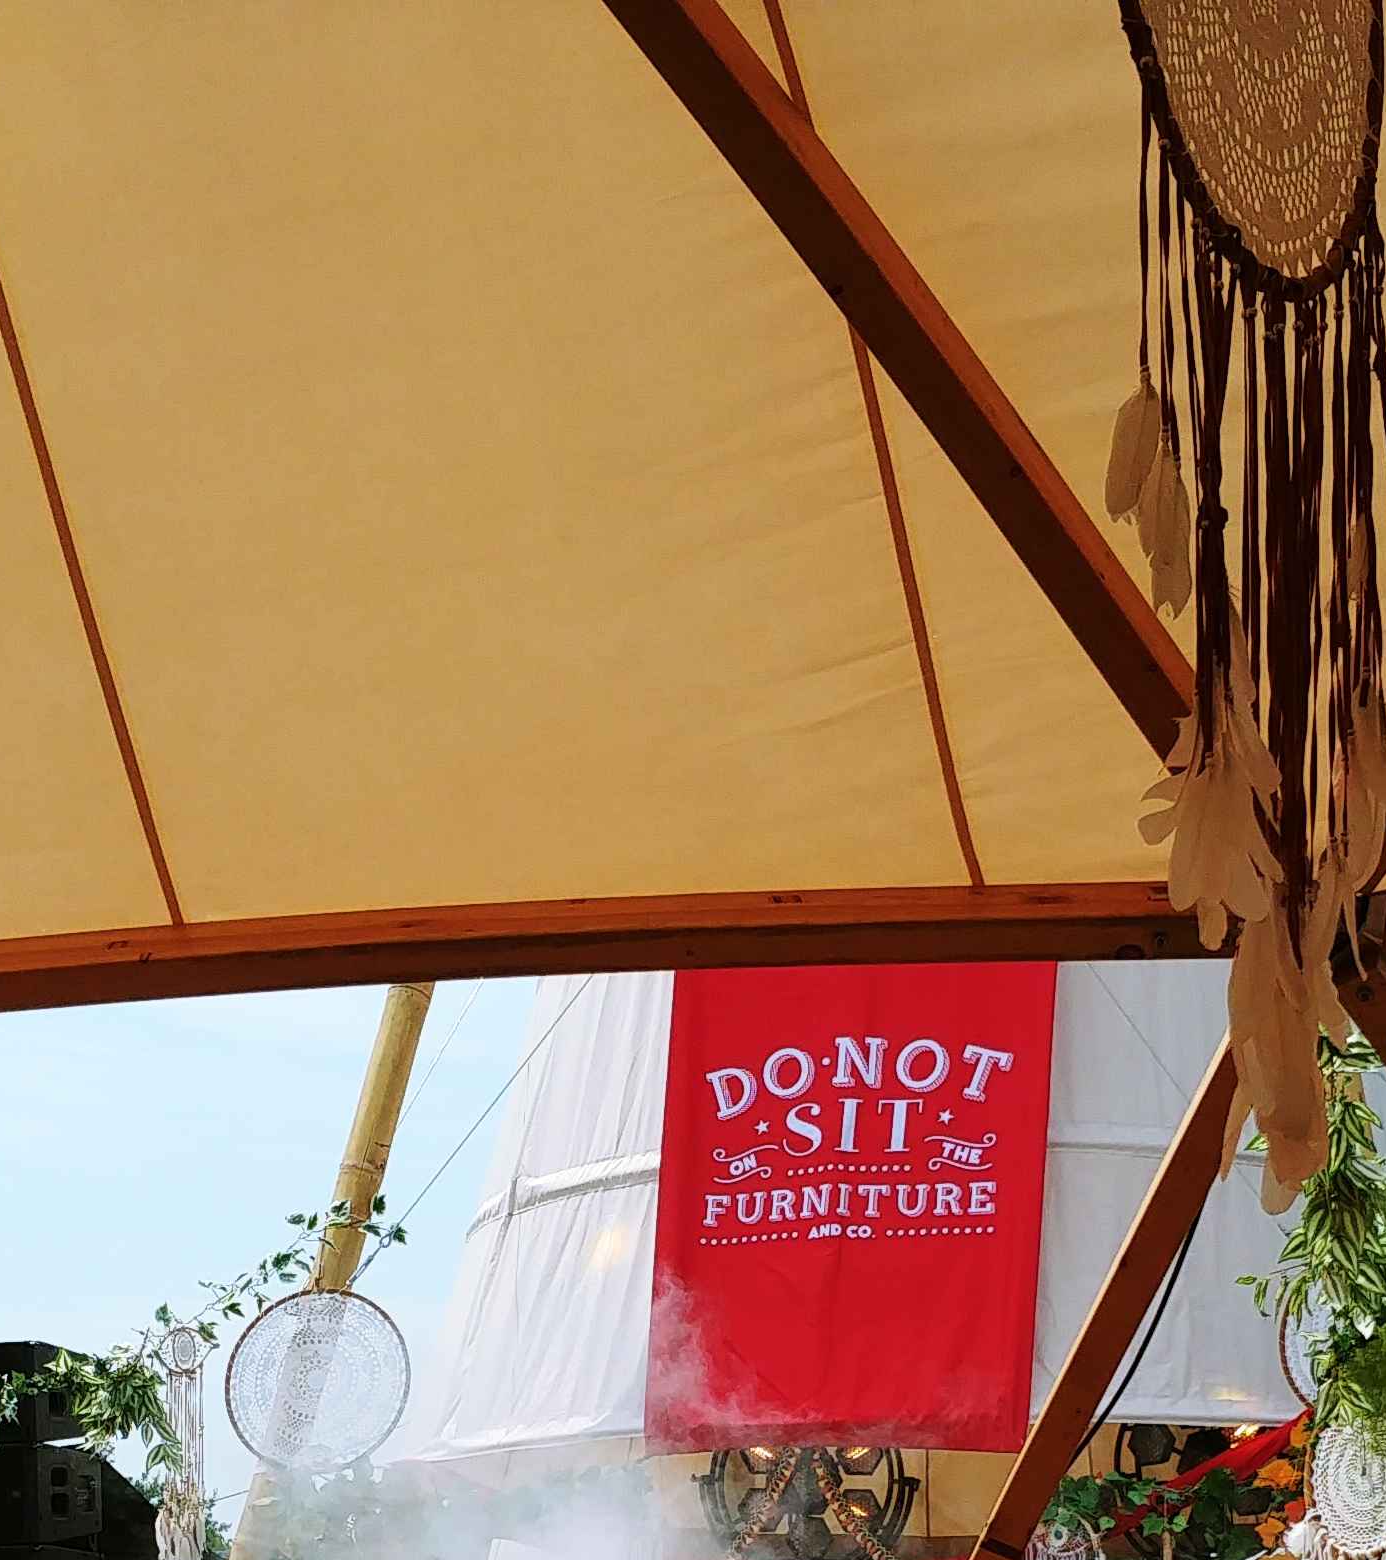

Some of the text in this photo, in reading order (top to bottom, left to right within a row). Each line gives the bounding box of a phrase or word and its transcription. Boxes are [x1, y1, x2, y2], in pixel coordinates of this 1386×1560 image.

[705, 1036, 1013, 1120] DO NOT
[783, 1098, 924, 1156] SIT
[728, 1153, 759, 1177] ON
[941, 1142, 983, 1166] THE
[702, 1181, 997, 1228] FURNITURE
[808, 1223, 876, 1240] AND CO.
